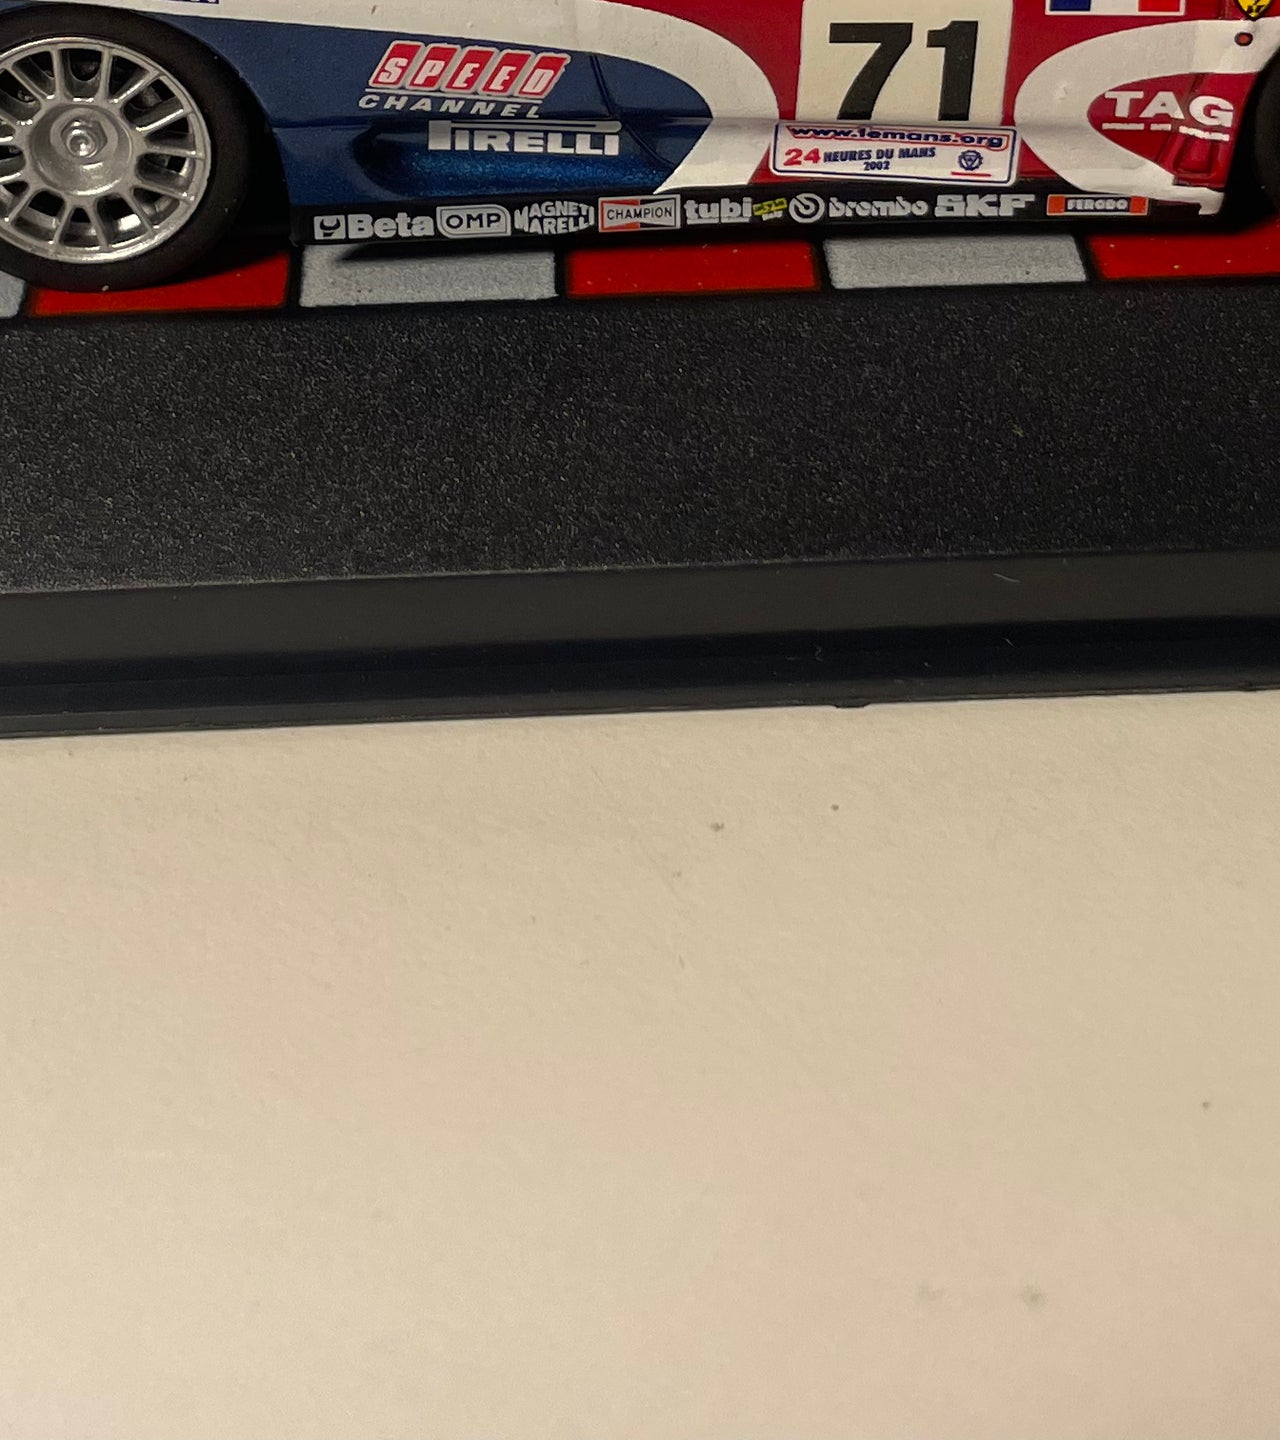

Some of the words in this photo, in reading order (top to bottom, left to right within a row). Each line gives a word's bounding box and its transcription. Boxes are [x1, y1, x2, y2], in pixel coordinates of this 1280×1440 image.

[372, 48, 565, 97] SPEED
[829, 20, 979, 122] 71
[358, 94, 540, 120] CHANNEL
[1104, 91, 1235, 128] TAG
[428, 120, 622, 156] PIRELLI
[790, 127, 1004, 149] www.lemans.org
[783, 148, 822, 166] 24
[823, 149, 872, 163] HEURES
[875, 148, 895, 160] DU
[898, 146, 937, 159] MANS
[863, 160, 891, 171] 2002
[606, 207, 673, 220] CHAMPION
[683, 196, 752, 219] tubi
[829, 196, 929, 217] brembo
[934, 194, 1036, 217] SKF
[348, 212, 435, 238] Beta
[445, 213, 502, 229] OMP
